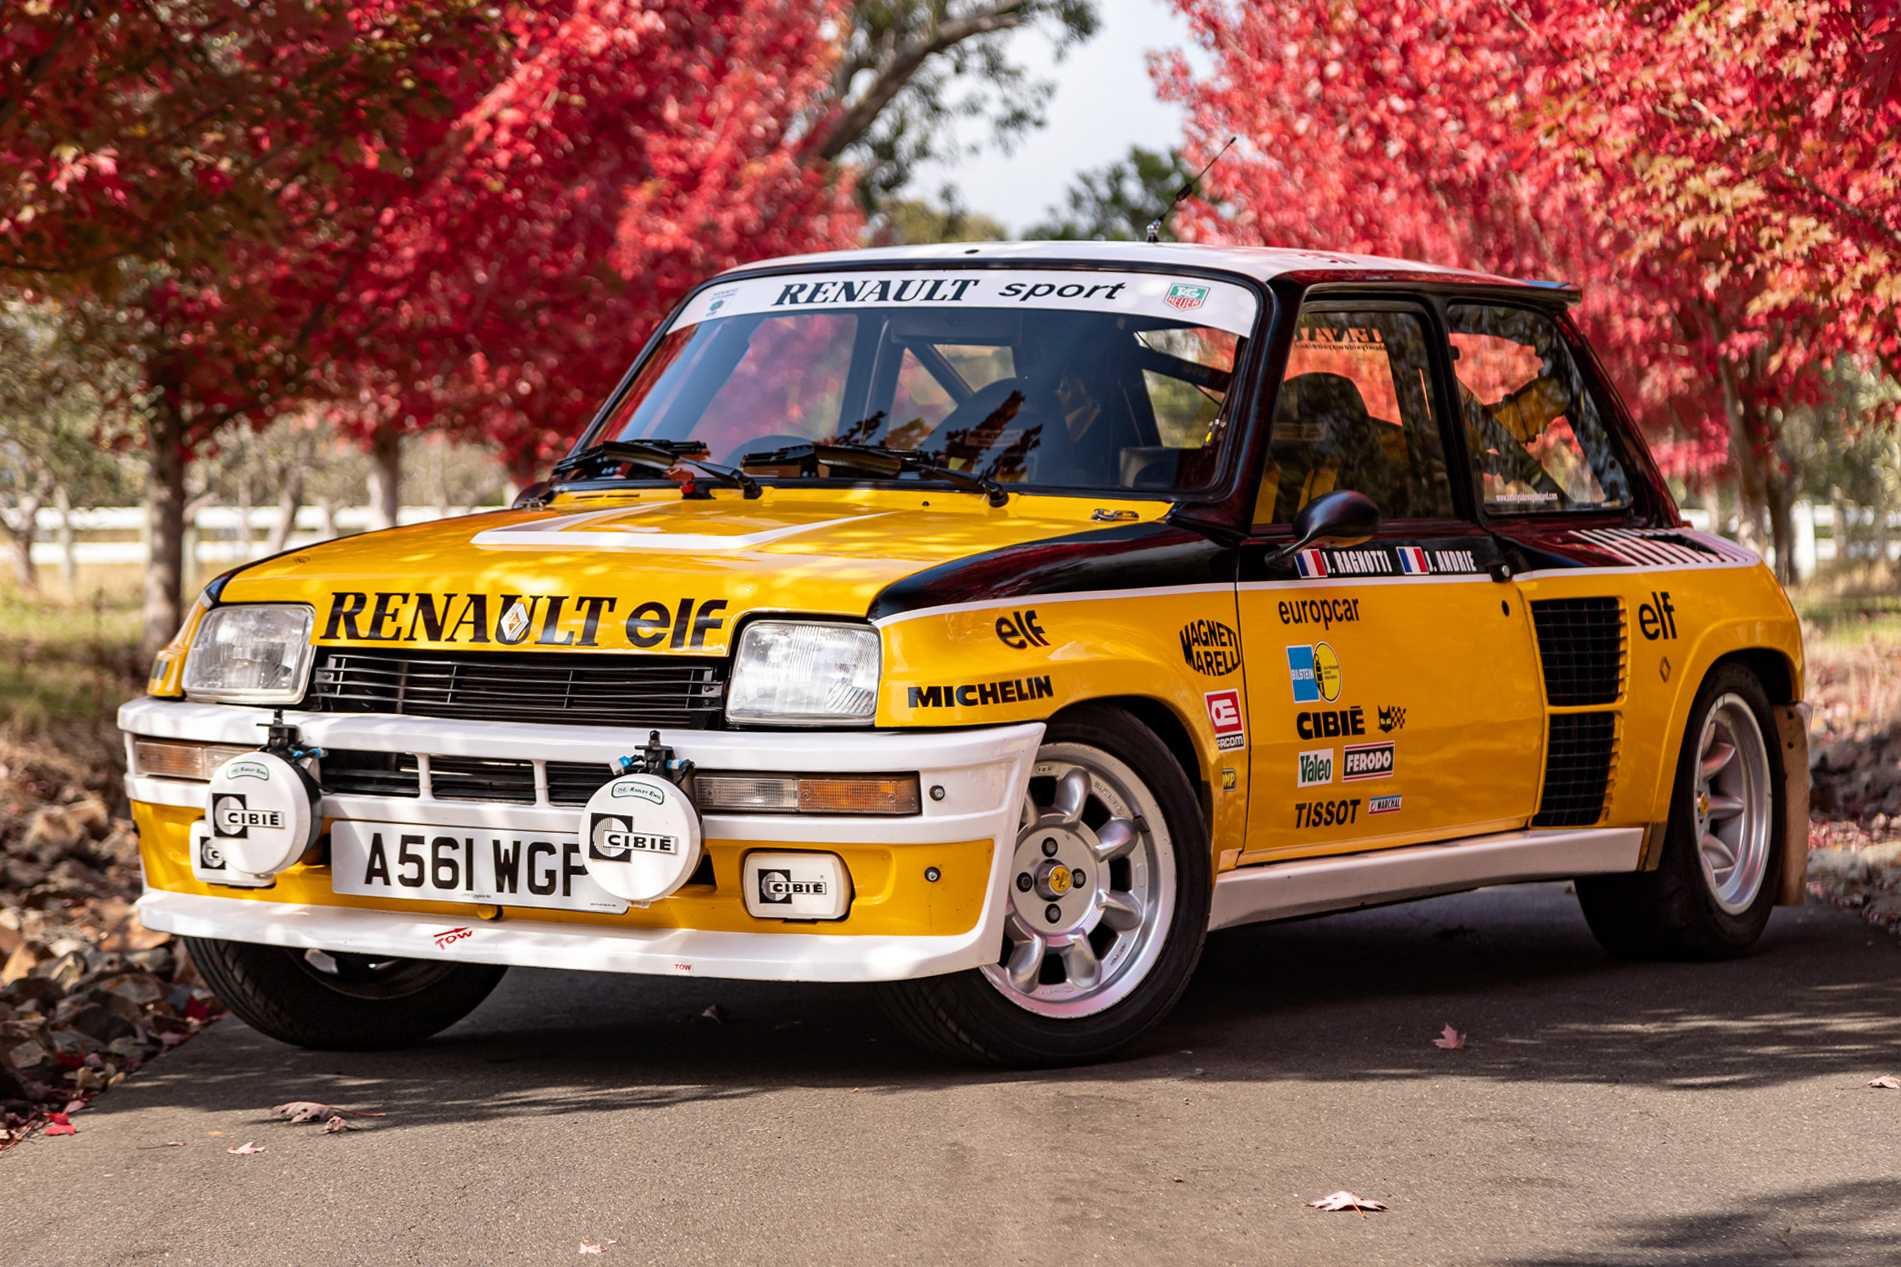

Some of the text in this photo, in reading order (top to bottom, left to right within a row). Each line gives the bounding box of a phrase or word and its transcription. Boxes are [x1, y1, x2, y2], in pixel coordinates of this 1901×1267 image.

[771, 279, 1126, 306] RENAULT sport
[1167, 296, 1202, 309] HEUER
[1177, 286, 1202, 299] TAG
[1322, 550, 1392, 574] J. RAGNOTTI
[1424, 550, 1477, 572] J. ANDRIE
[319, 592, 729, 649] RENAULT elf
[1278, 598, 1359, 631] europcar
[1638, 591, 1677, 641] elf
[995, 610, 1051, 650] elf
[1291, 668, 1314, 681] BILSTEIN
[907, 675, 1054, 708] MICHELIN
[1300, 754, 1332, 783] Valeo
[1346, 750, 1392, 773] FERODO
[1295, 799, 1361, 829] TISSOT
[1377, 798, 1401, 810] MARCHAL
[364, 832, 474, 892] A561
[434, 929, 473, 951] TOW
[674, 963, 692, 971] TOW
